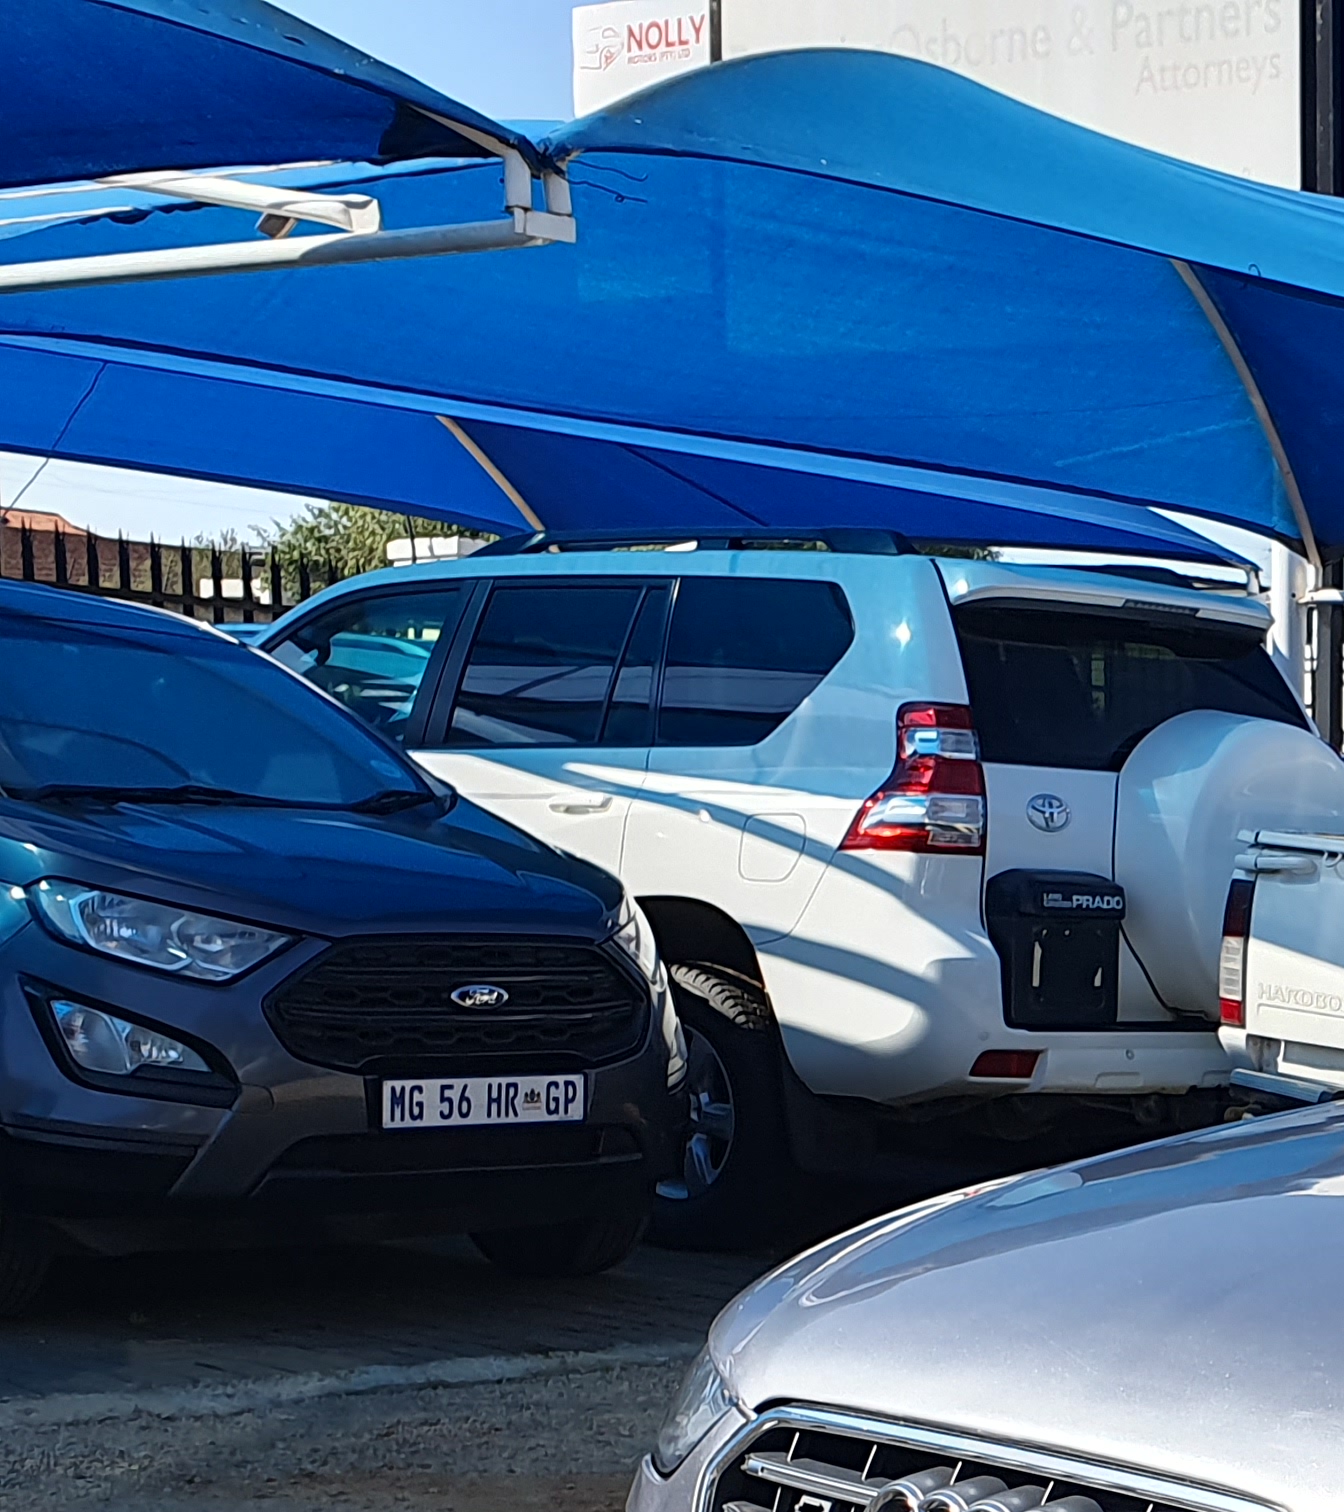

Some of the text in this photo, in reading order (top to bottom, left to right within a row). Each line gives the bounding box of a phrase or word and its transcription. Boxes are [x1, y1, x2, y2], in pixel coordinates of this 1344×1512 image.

[627, 13, 705, 53] NOLLY
[1068, 5, 1096, 56] &
[1110, 0, 1282, 51] Partners
[1134, 53, 1281, 96] Attorneys
[1072, 894, 1124, 910] PRADO
[465, 988, 499, 1007] Ford
[390, 1079, 578, 1122] MG 56 HR GP
